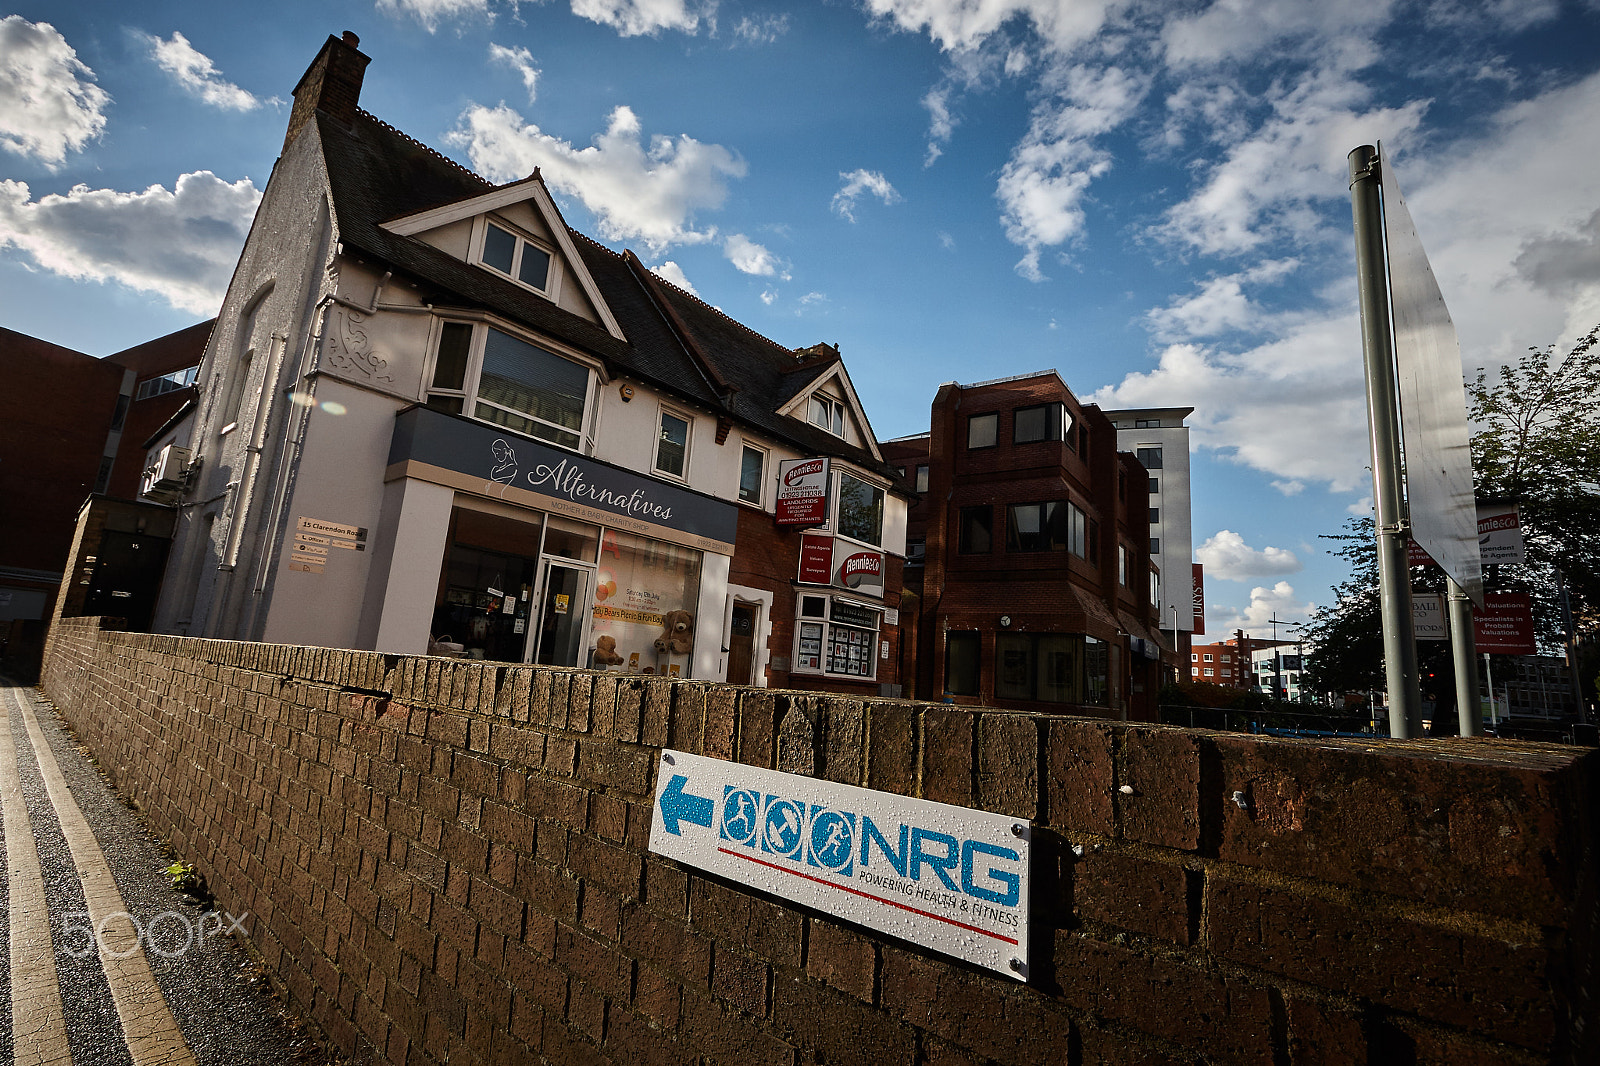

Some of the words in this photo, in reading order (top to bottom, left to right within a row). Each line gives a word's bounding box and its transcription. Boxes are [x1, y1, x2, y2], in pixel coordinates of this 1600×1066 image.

[527, 458, 673, 520] Alternatives
[782, 491, 799, 499] 01923
[783, 498, 819, 506] LANDLORDS
[551, 501, 580, 514] MOTHER
[587, 511, 605, 521] BABY
[605, 515, 632, 527] CHARITY
[633, 522, 649, 532] SHOP
[1478, 517, 1516, 532] nnie&Co
[312, 523, 346, 534] Clarendon
[346, 529, 363, 537] Road
[846, 554, 880, 574] Rennie&Co
[1193, 587, 1204, 620] JURYS
[604, 608, 620, 618] Bears
[620, 610, 637, 620] Picnic
[643, 613, 653, 621] Fun
[653, 615, 663, 625] Day
[860, 815, 1020, 908] NRG
[859, 871, 913, 896] POWERING
[915, 886, 958, 910] HEALTH
[959, 899, 969, 911] &
[973, 905, 1020, 928] FITNESS
